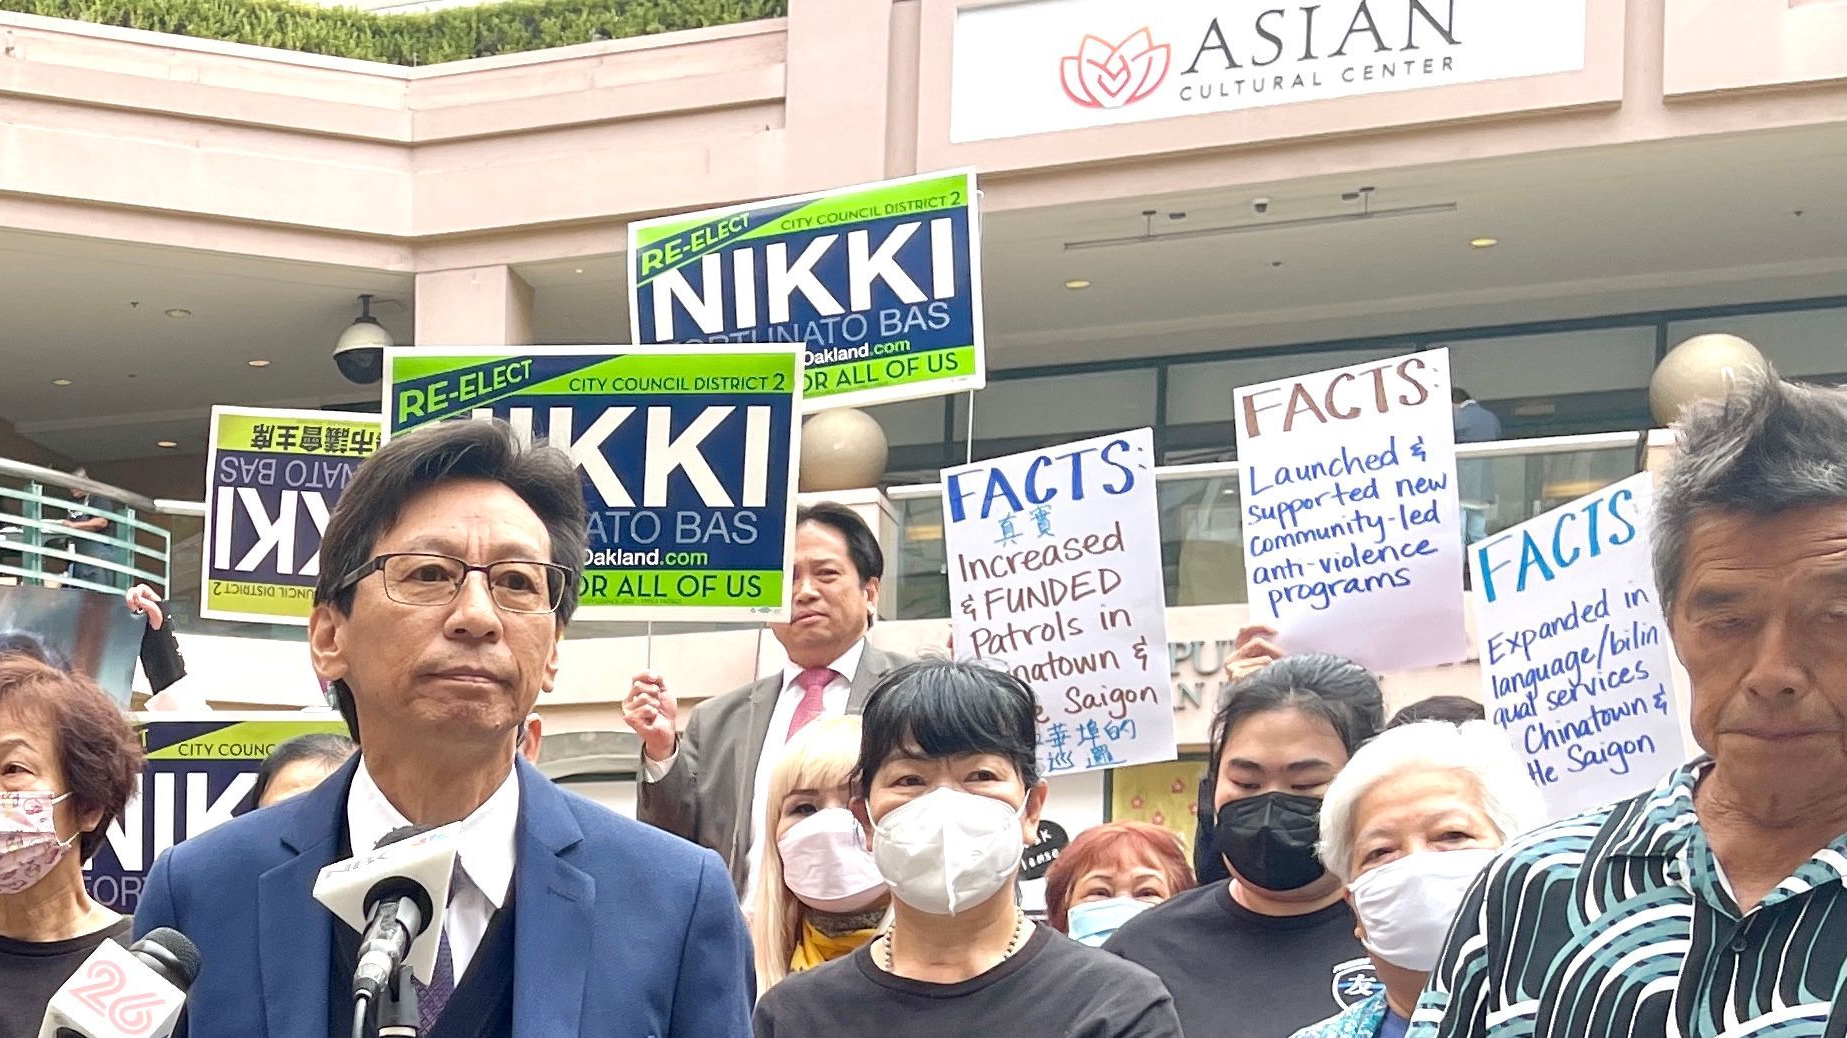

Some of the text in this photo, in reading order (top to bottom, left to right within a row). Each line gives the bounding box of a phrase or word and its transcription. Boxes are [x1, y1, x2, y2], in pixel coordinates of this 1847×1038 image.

[1181, 0, 1462, 76] ASIAN
[1180, 57, 1454, 101] CULTURAL CENTER
[780, 191, 961, 232] CITY COUNCIL DISTRICT 2
[641, 213, 751, 276] RE-ELECT
[653, 217, 956, 343] NIKKI
[879, 301, 952, 338] BAS
[398, 359, 533, 424] RE-ELECT
[569, 373, 785, 393] CITY COUNCIL DISTRICT 2
[835, 360, 880, 387] ALL
[886, 356, 920, 380] OF
[927, 352, 959, 372] US
[251, 423, 382, 456] 市議會主席
[220, 456, 276, 485] BAS
[947, 439, 1147, 523] FACTS:
[1250, 435, 1427, 496] Launched &
[1248, 472, 1447, 530] supported new
[585, 511, 758, 545] ATO BAS
[958, 520, 1125, 583] Increased
[1250, 499, 1441, 557] community-led
[617, 576, 667, 598] ALL
[677, 575, 716, 598] OF
[727, 575, 762, 598] US
[1253, 538, 1439, 585] anti-violence
[213, 581, 222, 596] 2
[224, 582, 275, 597] DISTRICT
[960, 568, 1122, 621] & FUNDED
[1268, 567, 1411, 618] programs
[970, 604, 1132, 661] Patrols in
[1487, 580, 1650, 665] Expanded in
[1006, 635, 1148, 684] natown &
[1492, 621, 1659, 701] language/bilin
[1064, 685, 1159, 719] Saigon
[1547, 660, 1650, 711] services
[1524, 683, 1668, 754] Chinatown &
[178, 743, 214, 757] CITY
[1567, 735, 1655, 775] Saigon
[68, 959, 167, 1035] 26
